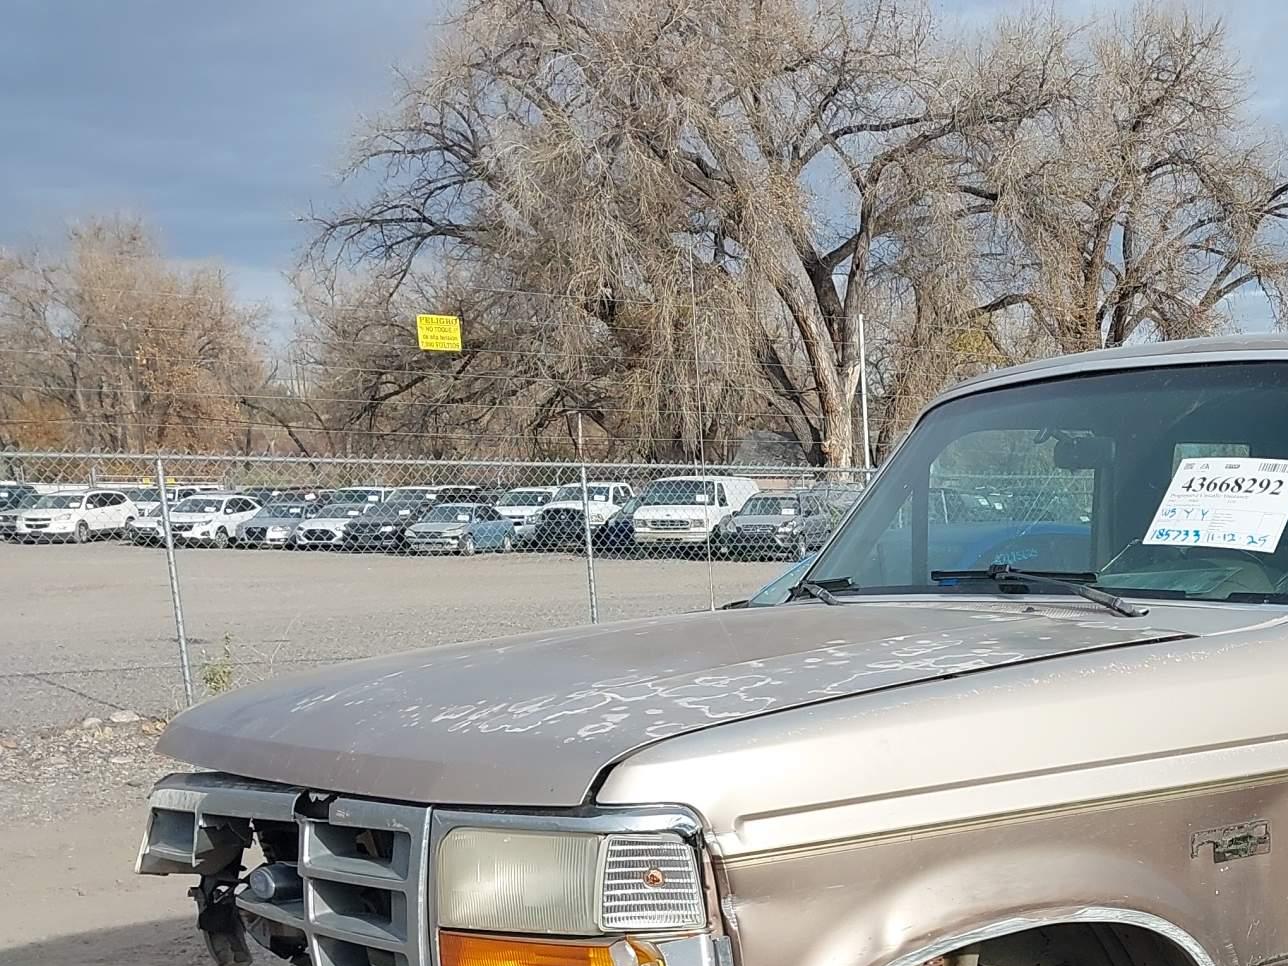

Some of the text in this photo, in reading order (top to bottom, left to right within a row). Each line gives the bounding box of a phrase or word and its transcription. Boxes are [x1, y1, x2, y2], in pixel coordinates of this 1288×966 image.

[419, 316, 458, 325] PELIGRO
[1181, 475, 1284, 496] 43668292
[1150, 527, 1201, 544] 185733
